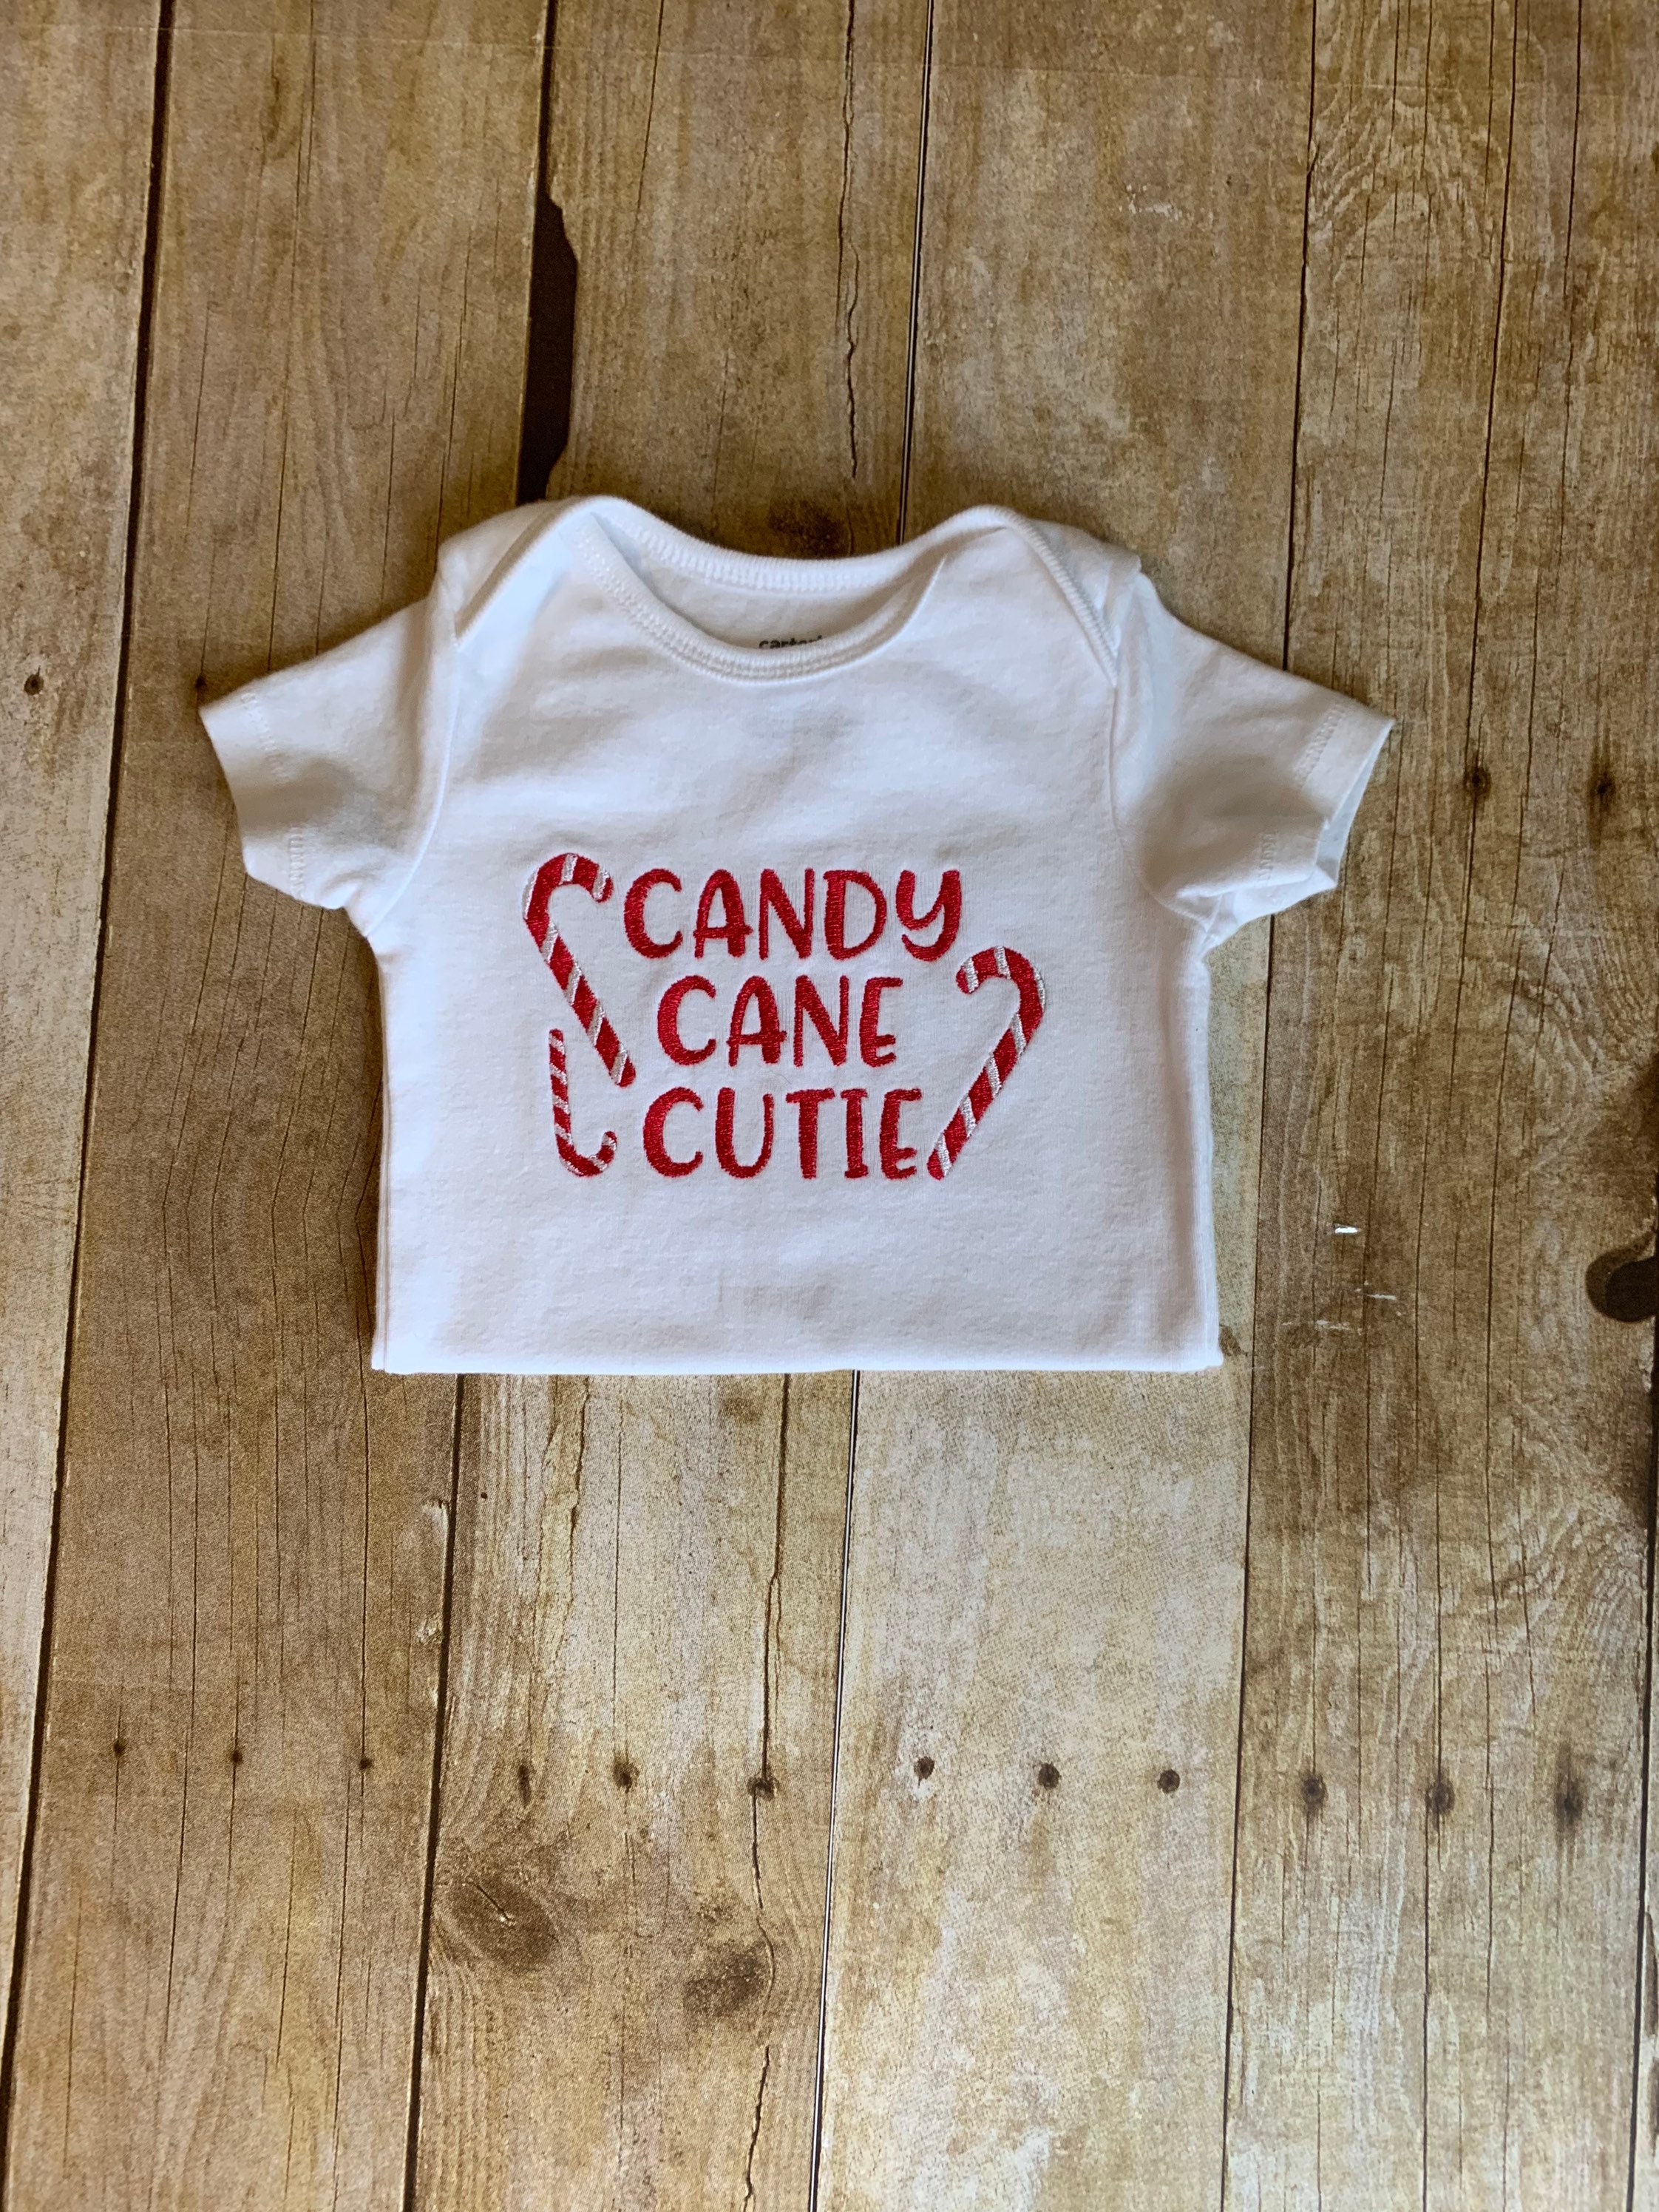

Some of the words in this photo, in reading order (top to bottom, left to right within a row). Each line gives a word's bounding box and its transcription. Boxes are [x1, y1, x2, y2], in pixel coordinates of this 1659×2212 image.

[623, 868, 963, 963] CANDY
[657, 975, 903, 1068] CANE
[642, 1087, 923, 1181] CUTIE
